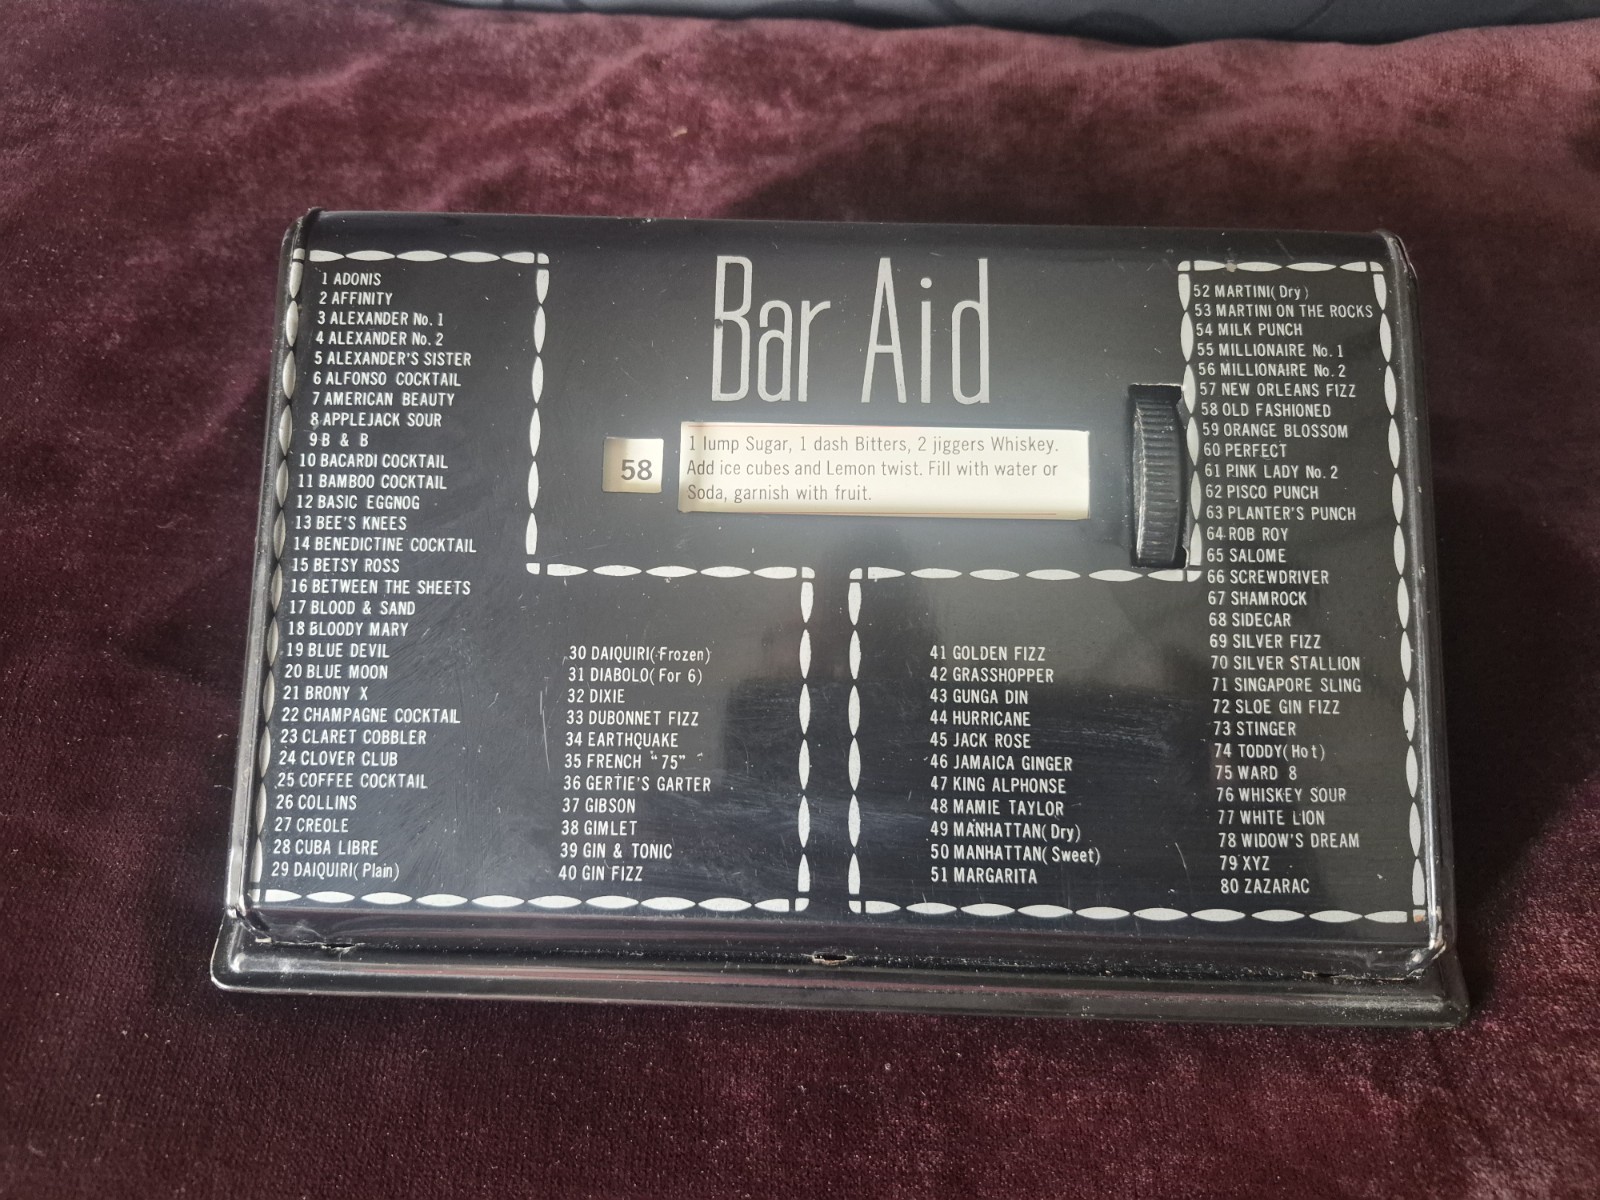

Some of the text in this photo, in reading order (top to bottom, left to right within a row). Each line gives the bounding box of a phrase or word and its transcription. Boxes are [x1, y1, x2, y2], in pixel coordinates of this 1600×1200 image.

[321, 272, 381, 286] 1 ADONIS
[1195, 304, 1373, 318] 53 MARTINI ON THE ROCKS
[712, 255, 990, 404] Bar Aid
[1196, 323, 1302, 336] 54 MILK PUNCH
[315, 351, 471, 366] 5 ALEXANDER'S SISTER
[1200, 382, 1355, 397] 57 NEW ORLEANS FIZZ
[313, 392, 454, 406] 7 AMERICAN BEAUTY
[1202, 402, 1331, 417] 58 OLD FASHIONED
[1203, 423, 1348, 438] 59 ORANGE BLOSSOM
[689, 436, 1058, 455] 1 lump Sugar, 1 dash Bitters, 2 jiggers Whiskey.
[300, 453, 448, 468] 10 BACARDI COCKTAIL
[687, 460, 1057, 476] Add ice cubes and Lemon twist. Fill with water or
[621, 460, 652, 480] 58
[1205, 463, 1338, 479] 61 PINK LADY No. 2
[688, 484, 871, 503] Soda, garnish with fruit.
[297, 495, 419, 509] 12 BASIC EGGNOG
[1207, 505, 1355, 520] 63 PLANTER'S PUNCH
[295, 536, 476, 552] 14 BENEDICTINE COCKTAIL
[1208, 569, 1328, 584] 66 SCREWDRIVER
[291, 579, 470, 595] 16 BETWEEN THE SHEETS
[1208, 591, 1306, 605] 67 SHAMROCK
[930, 645, 1045, 661] 41 GOLDEN FIZZ
[1211, 655, 1360, 670] 70 SILVER STALLION
[285, 664, 388, 679] 20 BLUE MOON
[930, 667, 1053, 682] 42 GRASSHOPPER
[1213, 677, 1361, 692] 71 SINGAPORE SLING
[568, 688, 625, 703] 32 DIXIE
[1213, 699, 1339, 714] 72 SLOE GIN FIZZ
[282, 707, 460, 723] 22 CHAMPAGNE COCKTAIL
[567, 710, 698, 726] 33 DUBONNET FIZZ
[930, 710, 1030, 726] 44 HURRICANE
[566, 732, 678, 749] 34 EARTHQUAKE
[930, 732, 1031, 748] 45 JACK ROSE
[279, 750, 397, 766] 24 CLOVER CLUB
[931, 754, 1072, 771] 46 JAMAICA GINGER
[564, 775, 710, 791] 36 GERTIE'S GARTER
[931, 776, 1066, 793] 47 KING ALPHONSE
[276, 794, 357, 810] 26 COLLINS
[1217, 787, 1346, 802] 76 WHISKEY SOUR
[563, 798, 635, 813] 37 GIBSON
[931, 798, 1063, 816] 48 MAMIE TAYLOR
[273, 839, 378, 855] 28 CUBA LIBRE
[1219, 833, 1359, 848] 78 WIDOW'S DREAM
[561, 842, 672, 859] 39 GIN & TONIC
[559, 865, 643, 881] 40 GIN FIZZ
[931, 867, 1037, 884] 51 MARGARITA
[1221, 878, 1309, 893] 80 ZAZARAC
